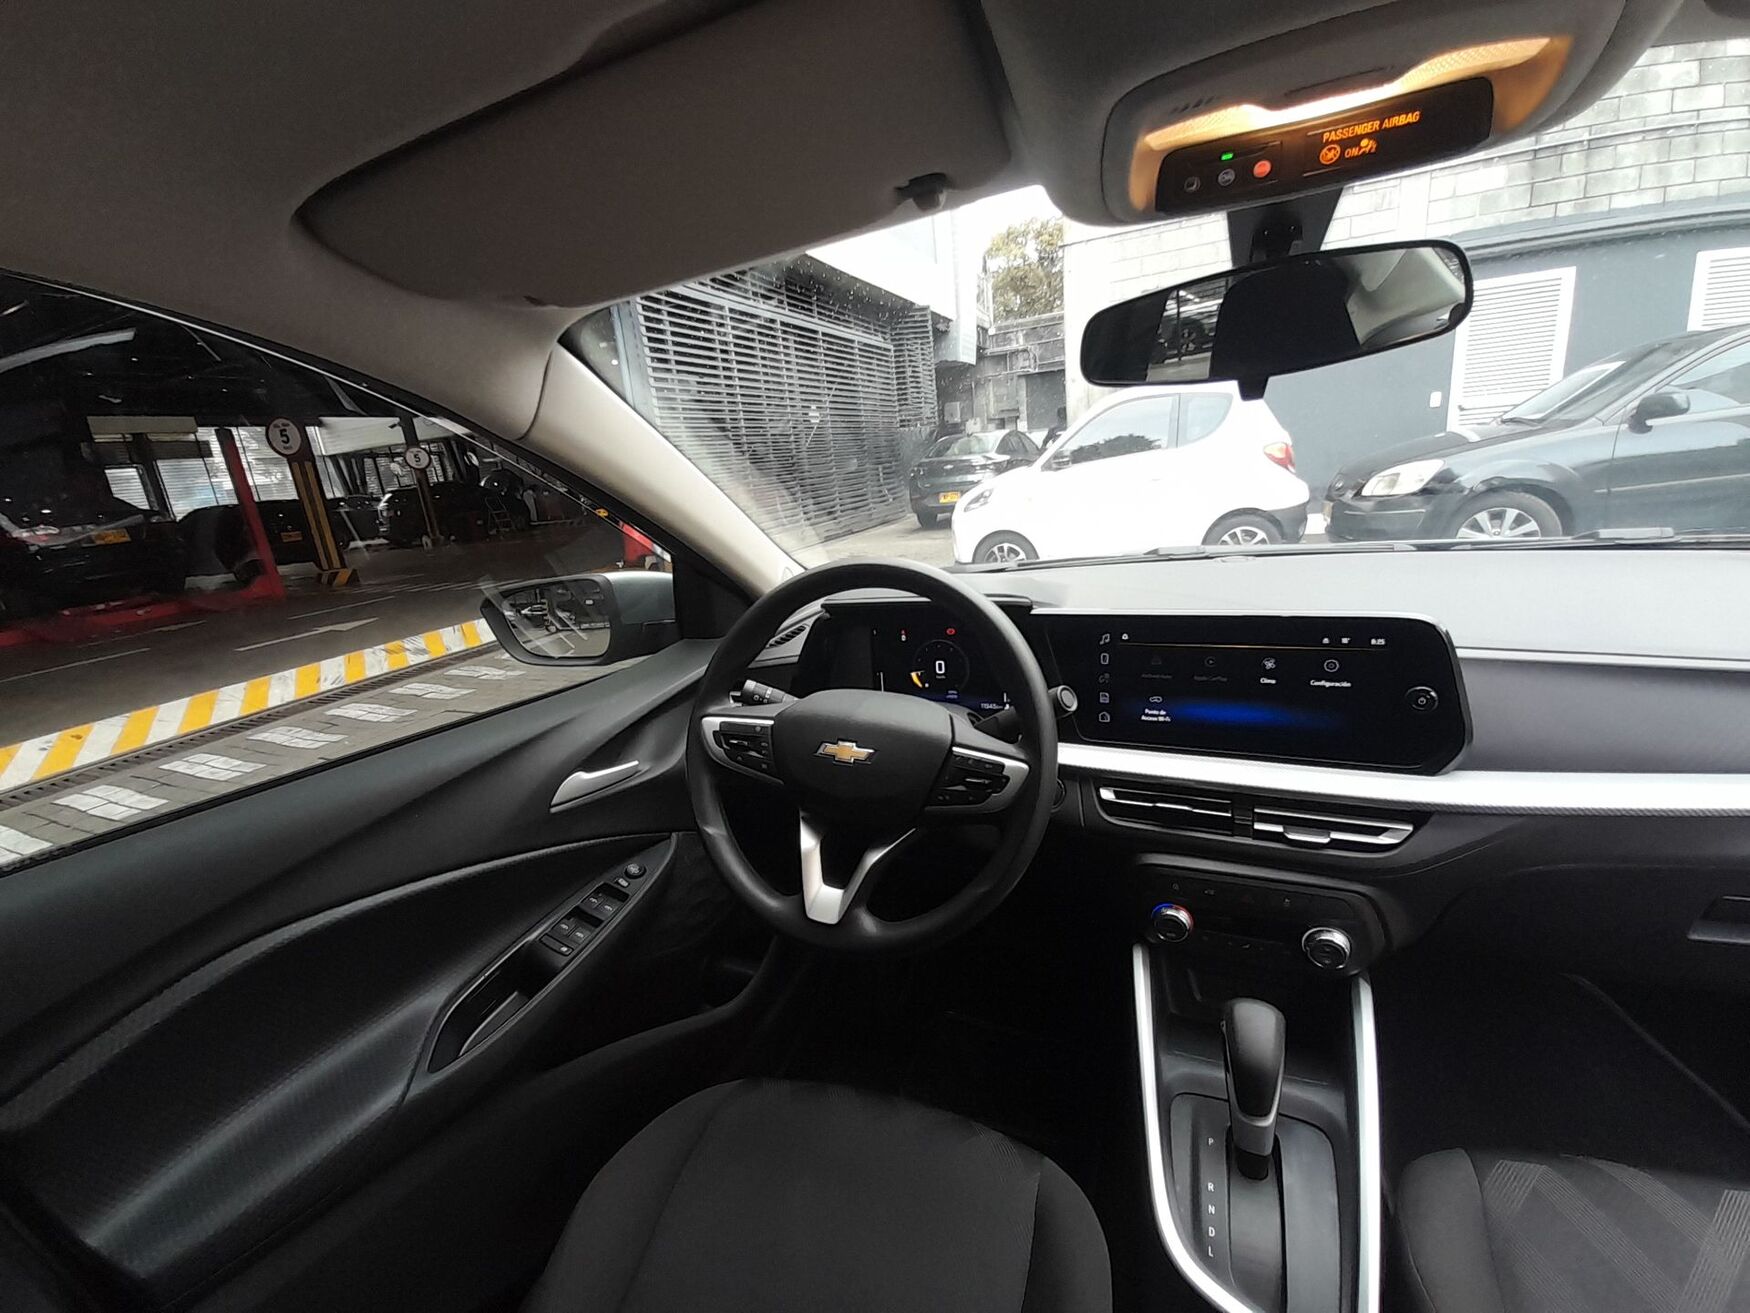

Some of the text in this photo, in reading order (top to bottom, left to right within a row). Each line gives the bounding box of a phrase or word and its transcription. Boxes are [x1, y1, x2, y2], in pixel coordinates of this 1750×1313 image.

[1323, 111, 1420, 142] PASSENGER AIRBAG
[279, 428, 289, 444] 5
[413, 453, 421, 463] 5
[935, 660, 945, 674] 0
[1208, 1138, 1214, 1146] P
[1207, 1182, 1215, 1192] R
[1208, 1204, 1215, 1214] N
[1208, 1226, 1215, 1237] D
[1208, 1246, 1214, 1257] L
